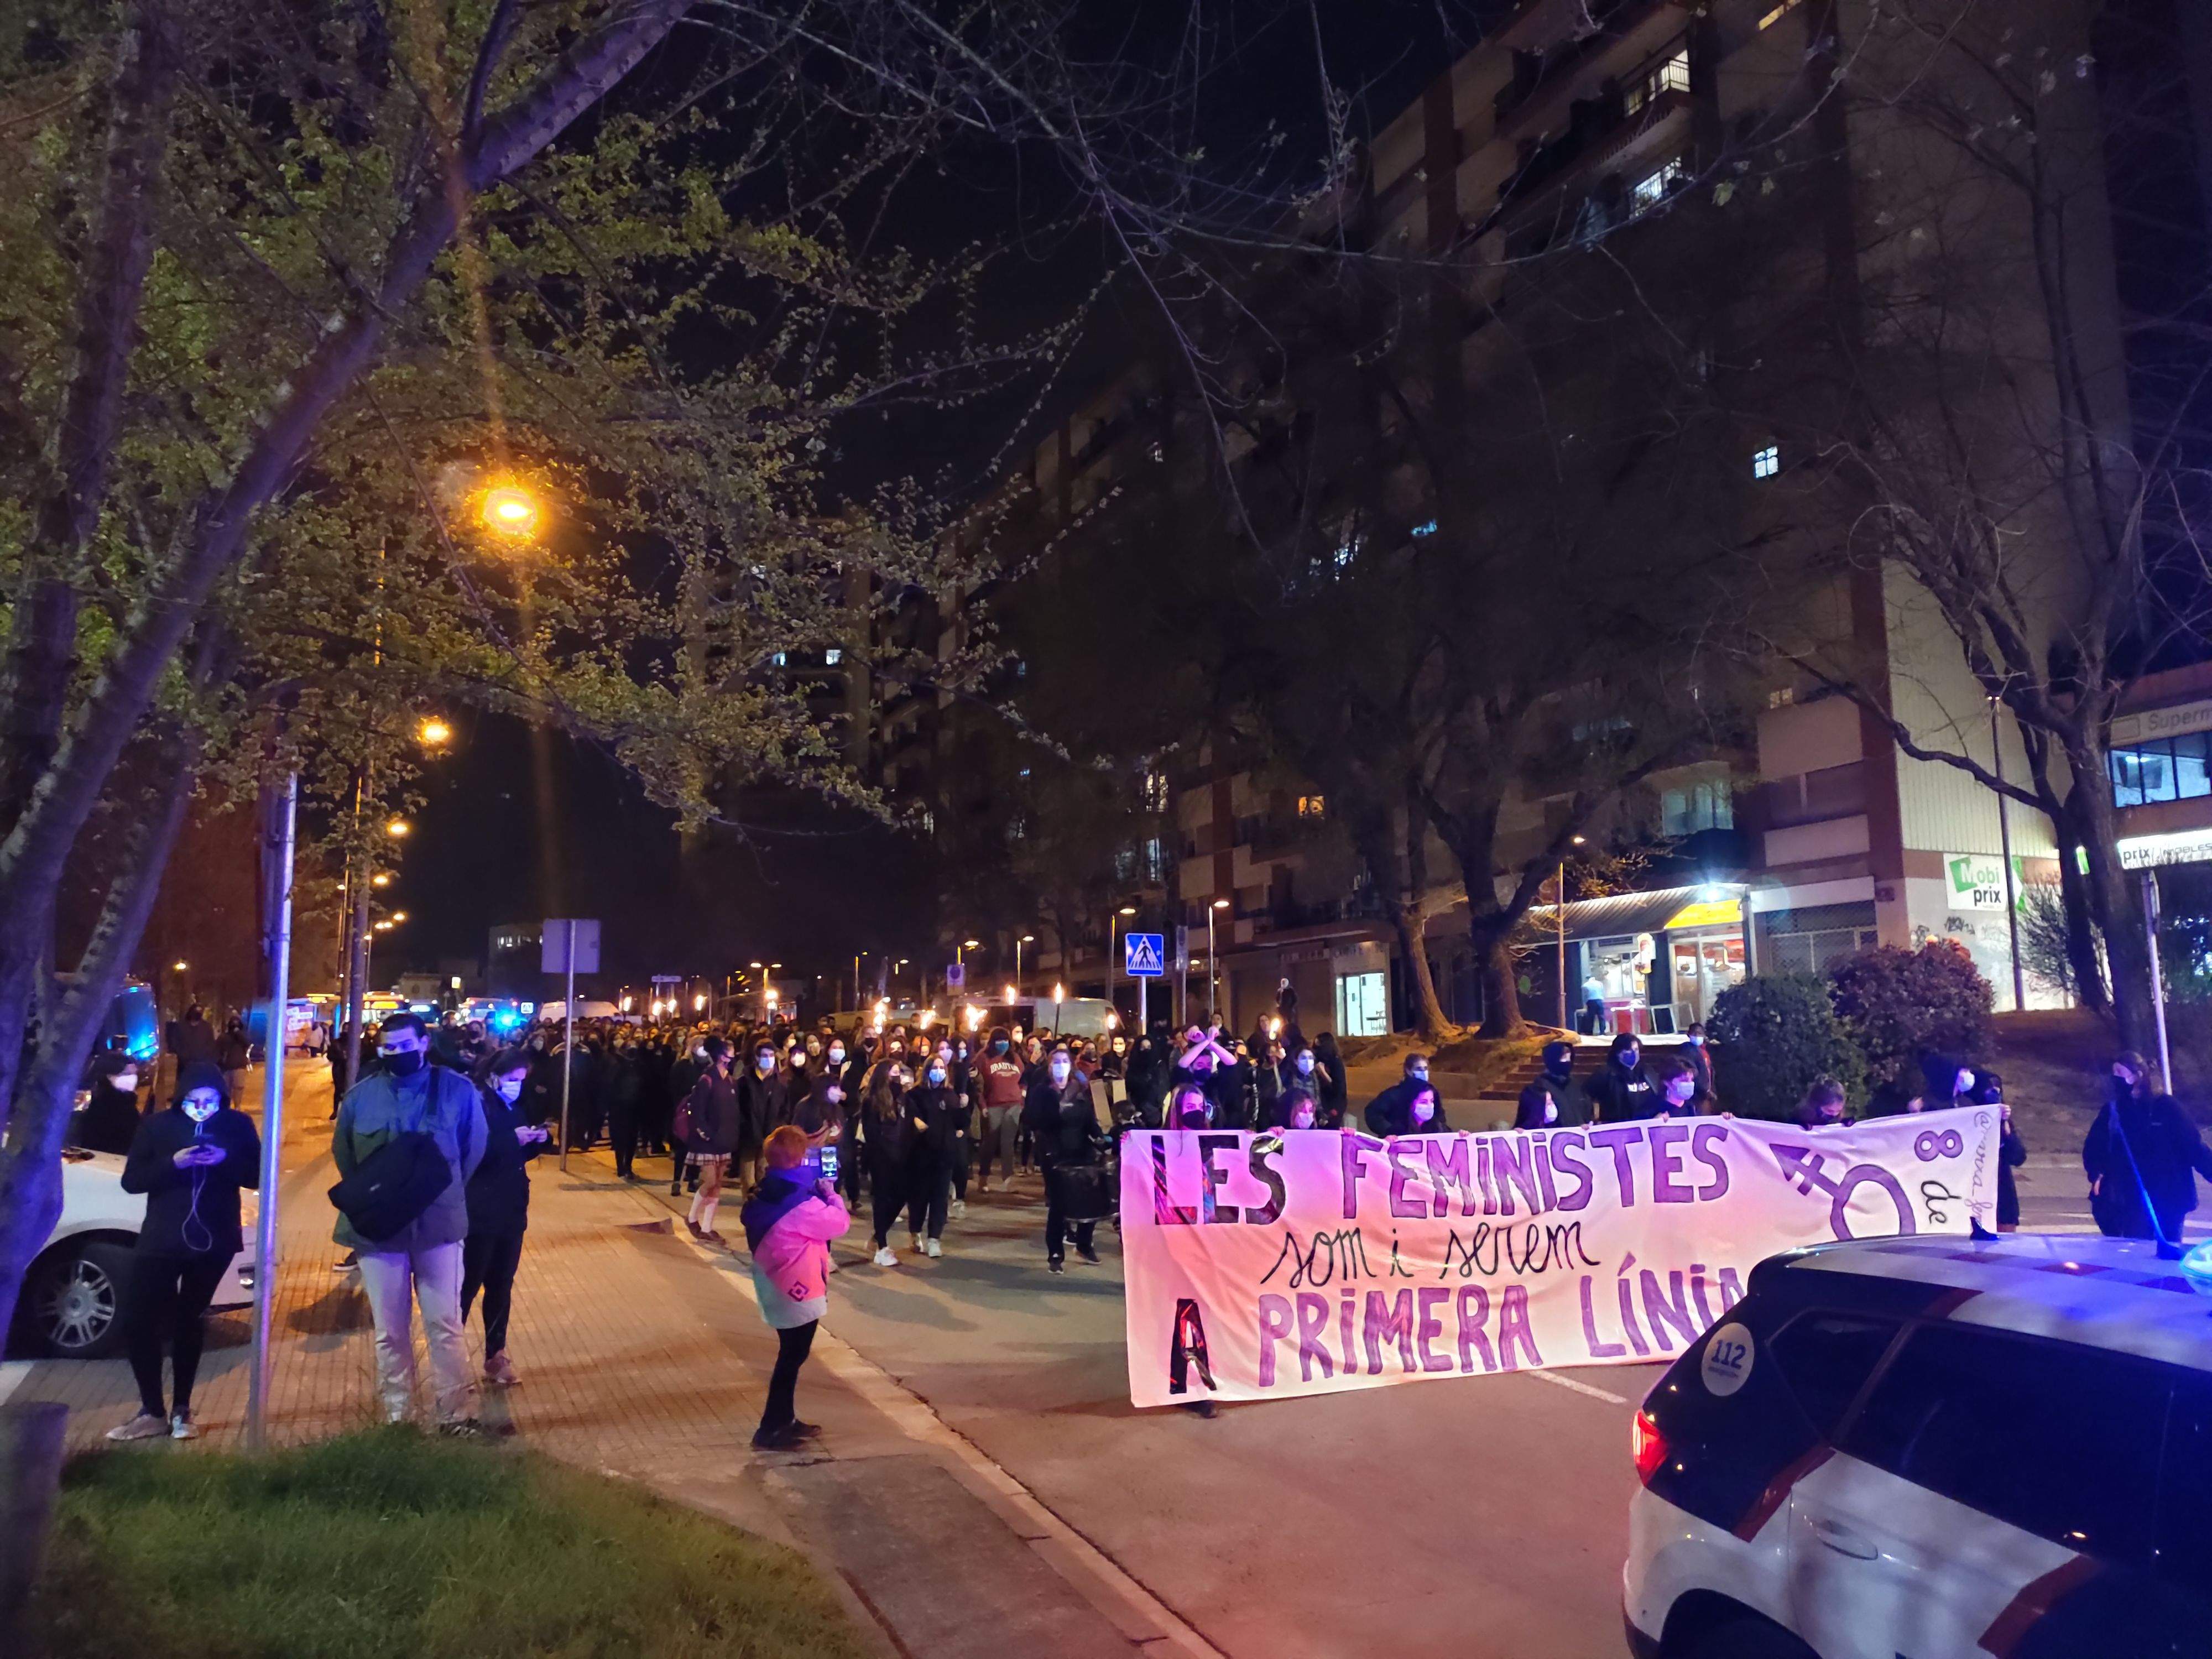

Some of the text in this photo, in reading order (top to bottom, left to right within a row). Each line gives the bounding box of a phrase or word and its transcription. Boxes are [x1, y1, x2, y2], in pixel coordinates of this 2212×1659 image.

[1960, 862, 2000, 884] Mobi
[2123, 846, 2151, 864] prix
[1974, 885, 2001, 907] prix
[1151, 1135, 1286, 1225] LES
[1914, 1129, 1963, 1225] 8 de
[1260, 1221, 1601, 1288] som i serem
[1169, 1297, 1217, 1395] A
[1711, 1339, 1746, 1370] 112
